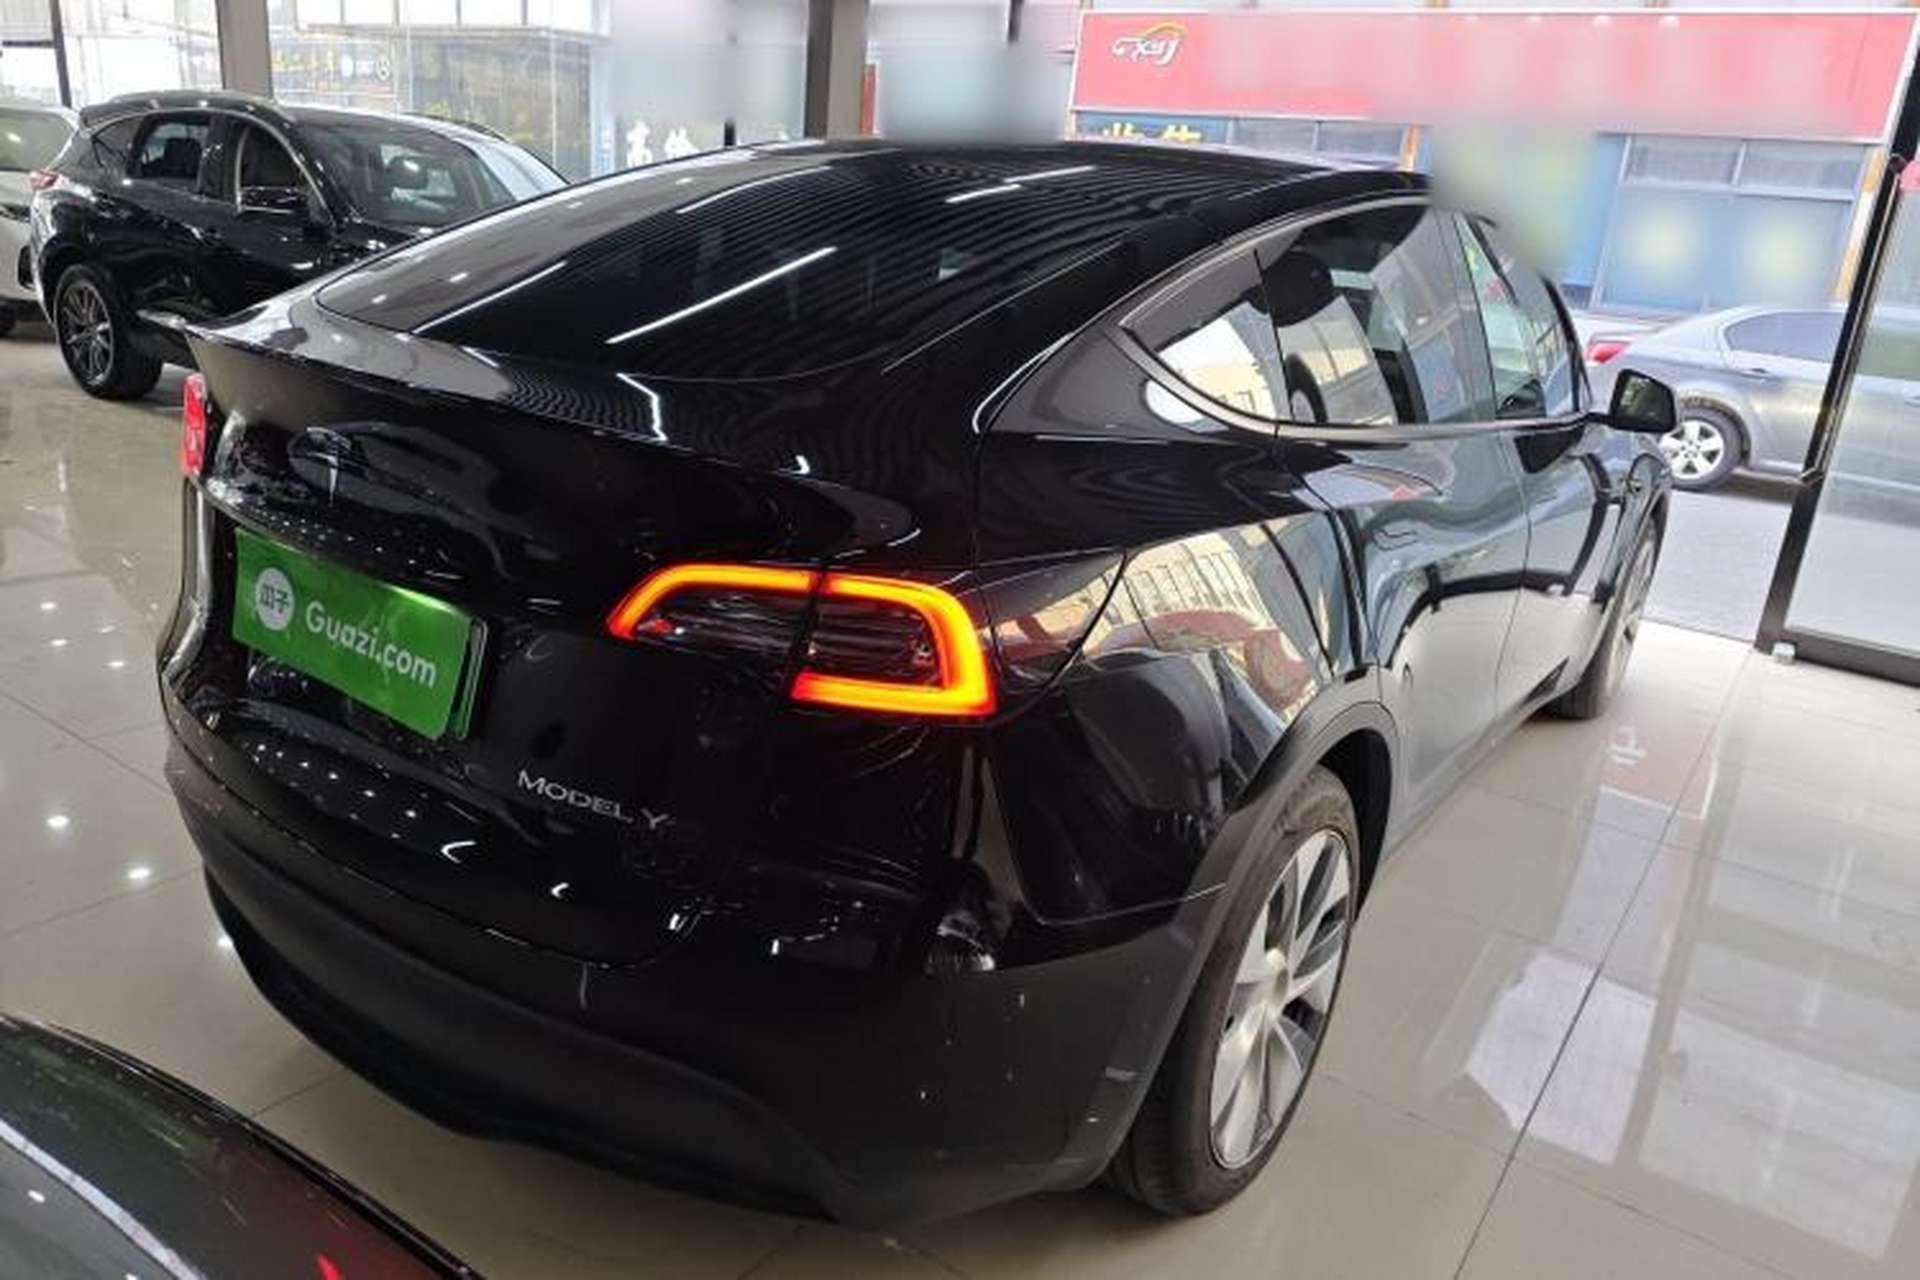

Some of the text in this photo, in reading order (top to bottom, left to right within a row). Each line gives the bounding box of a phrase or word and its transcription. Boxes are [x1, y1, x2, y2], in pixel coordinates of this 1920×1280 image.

[306, 600, 437, 688] Guazi.com
[518, 769, 669, 830] MODEL Y
